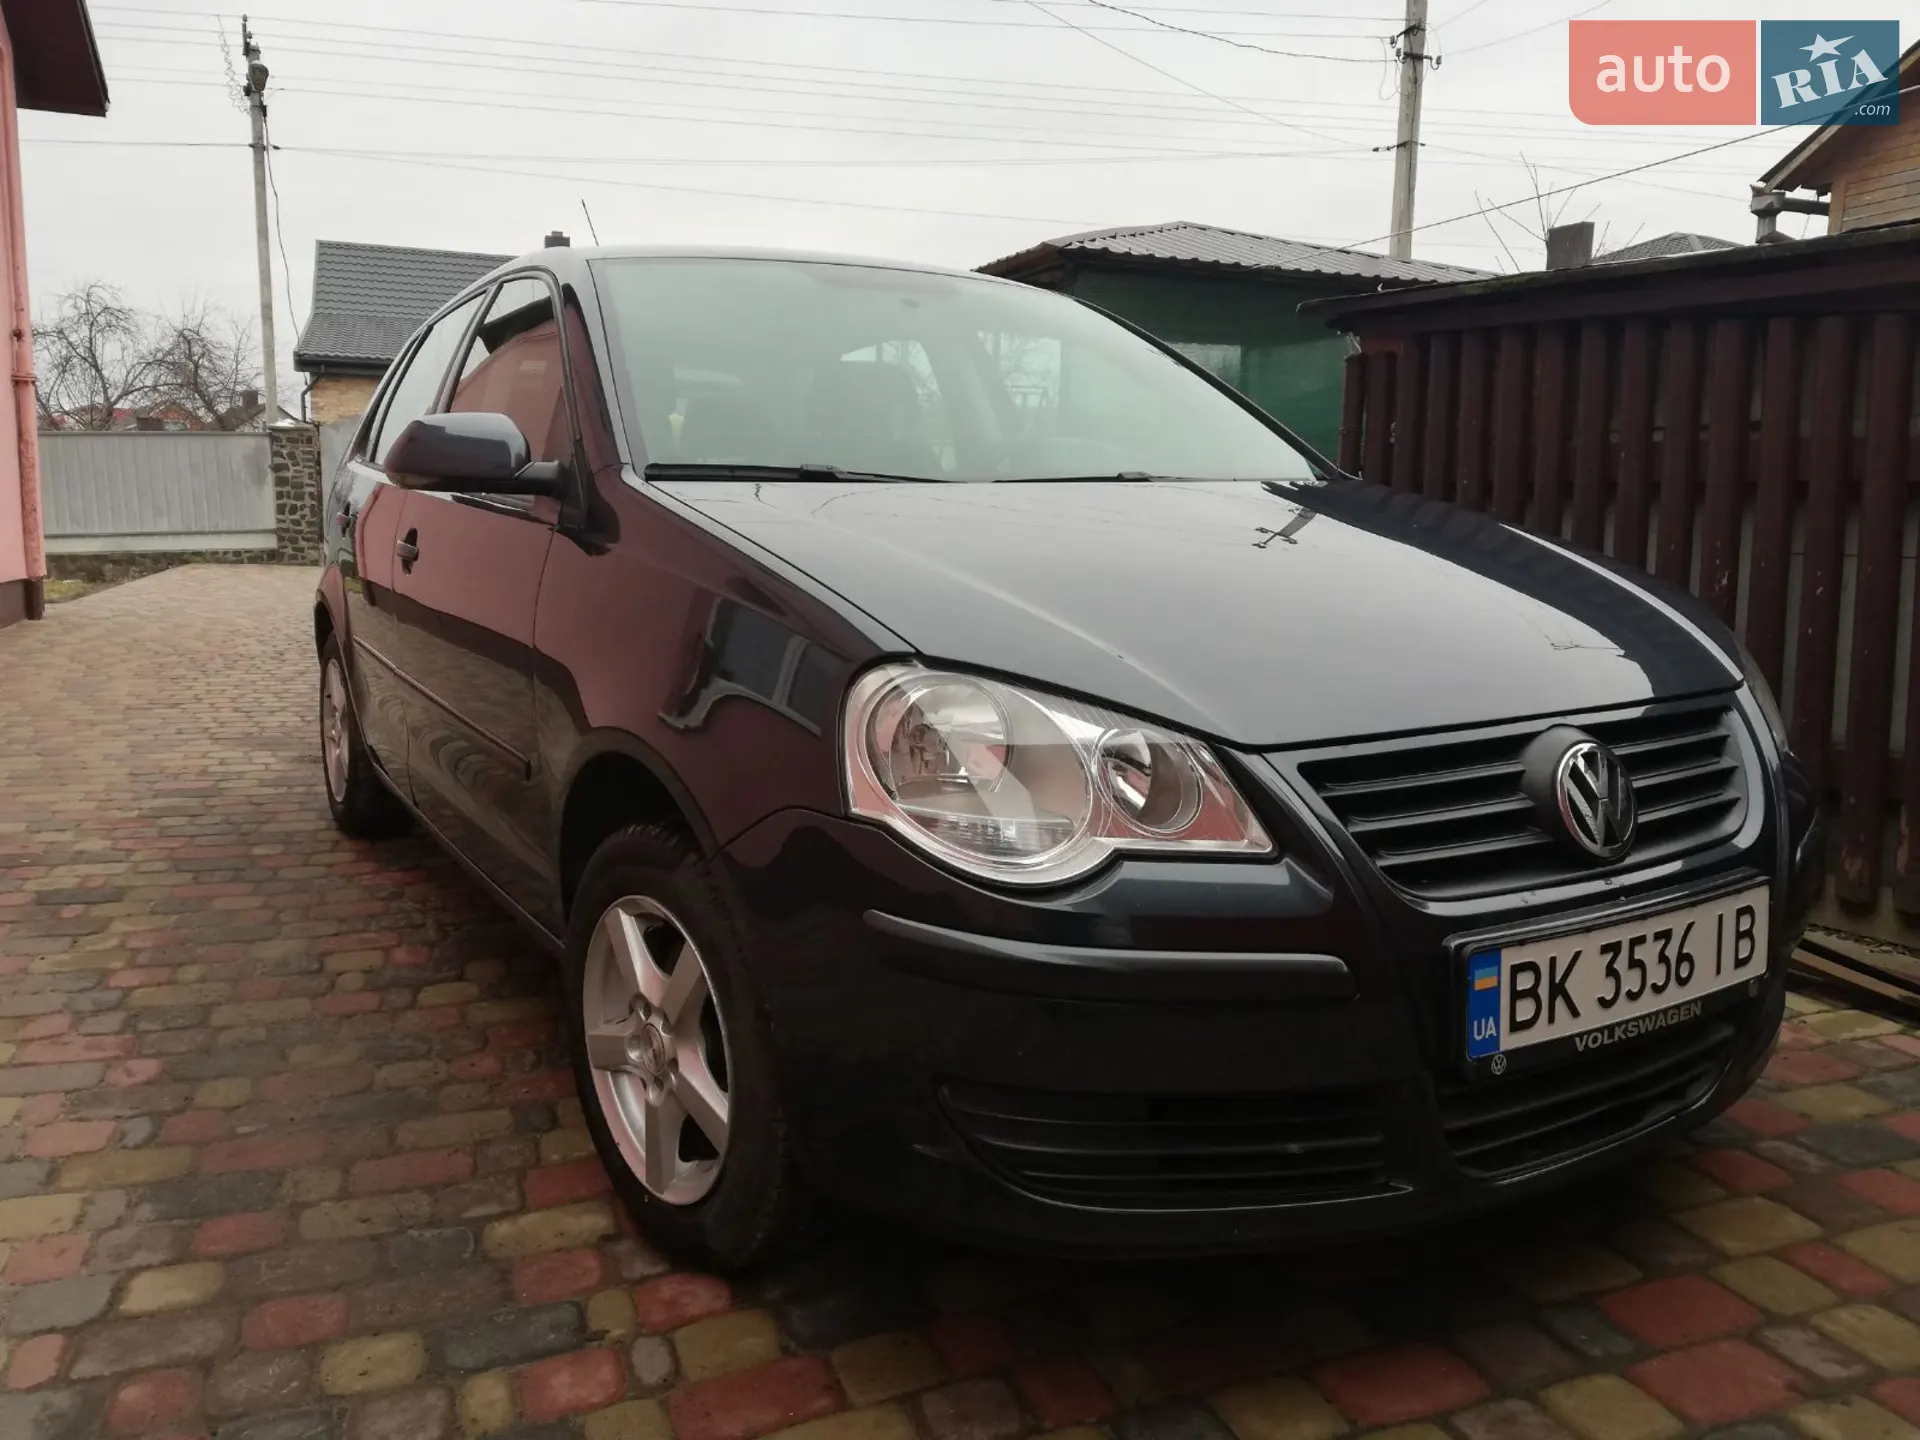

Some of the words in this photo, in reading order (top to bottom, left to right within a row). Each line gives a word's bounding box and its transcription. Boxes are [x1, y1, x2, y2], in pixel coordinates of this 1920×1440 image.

[1509, 950, 1583, 1033] BK
[1597, 921, 1696, 1009] 3536
[1715, 904, 1756, 977] IB
[1473, 1016, 1497, 1040] UA
[1574, 1000, 1702, 1052] VOLKSWAGEN
